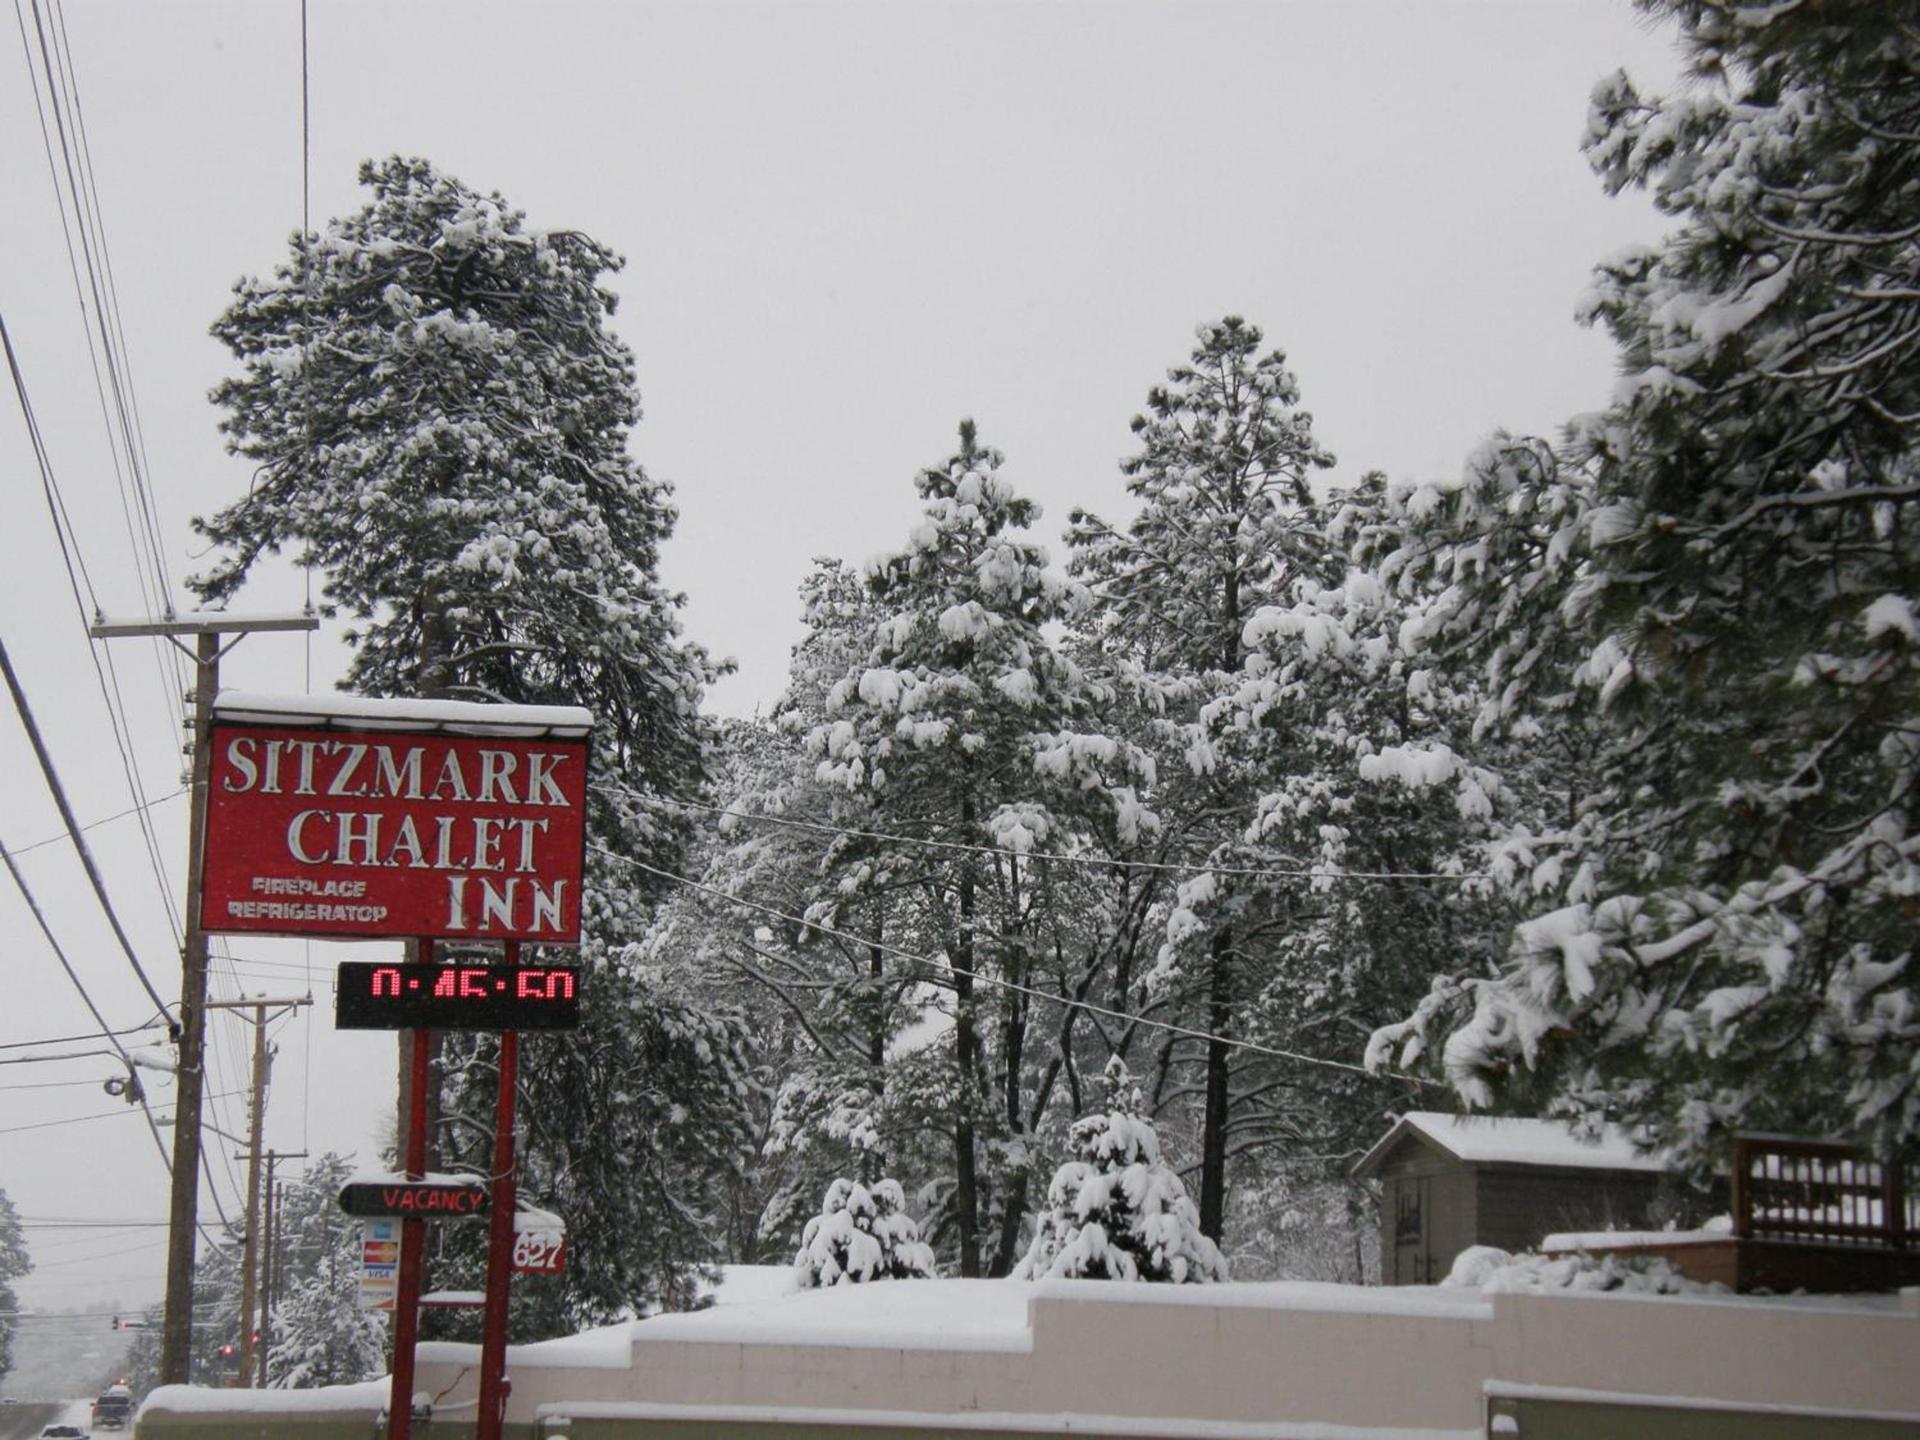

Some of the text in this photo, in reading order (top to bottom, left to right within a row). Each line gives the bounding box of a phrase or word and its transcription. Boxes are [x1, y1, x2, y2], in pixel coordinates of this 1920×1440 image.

[223, 736, 571, 807] SITZMARK
[286, 809, 548, 872] CHALET
[251, 876, 367, 898] FIREPLACE
[445, 875, 568, 932] INN
[383, 1187, 483, 1212] VACANCY
[513, 1230, 563, 1268] 627
